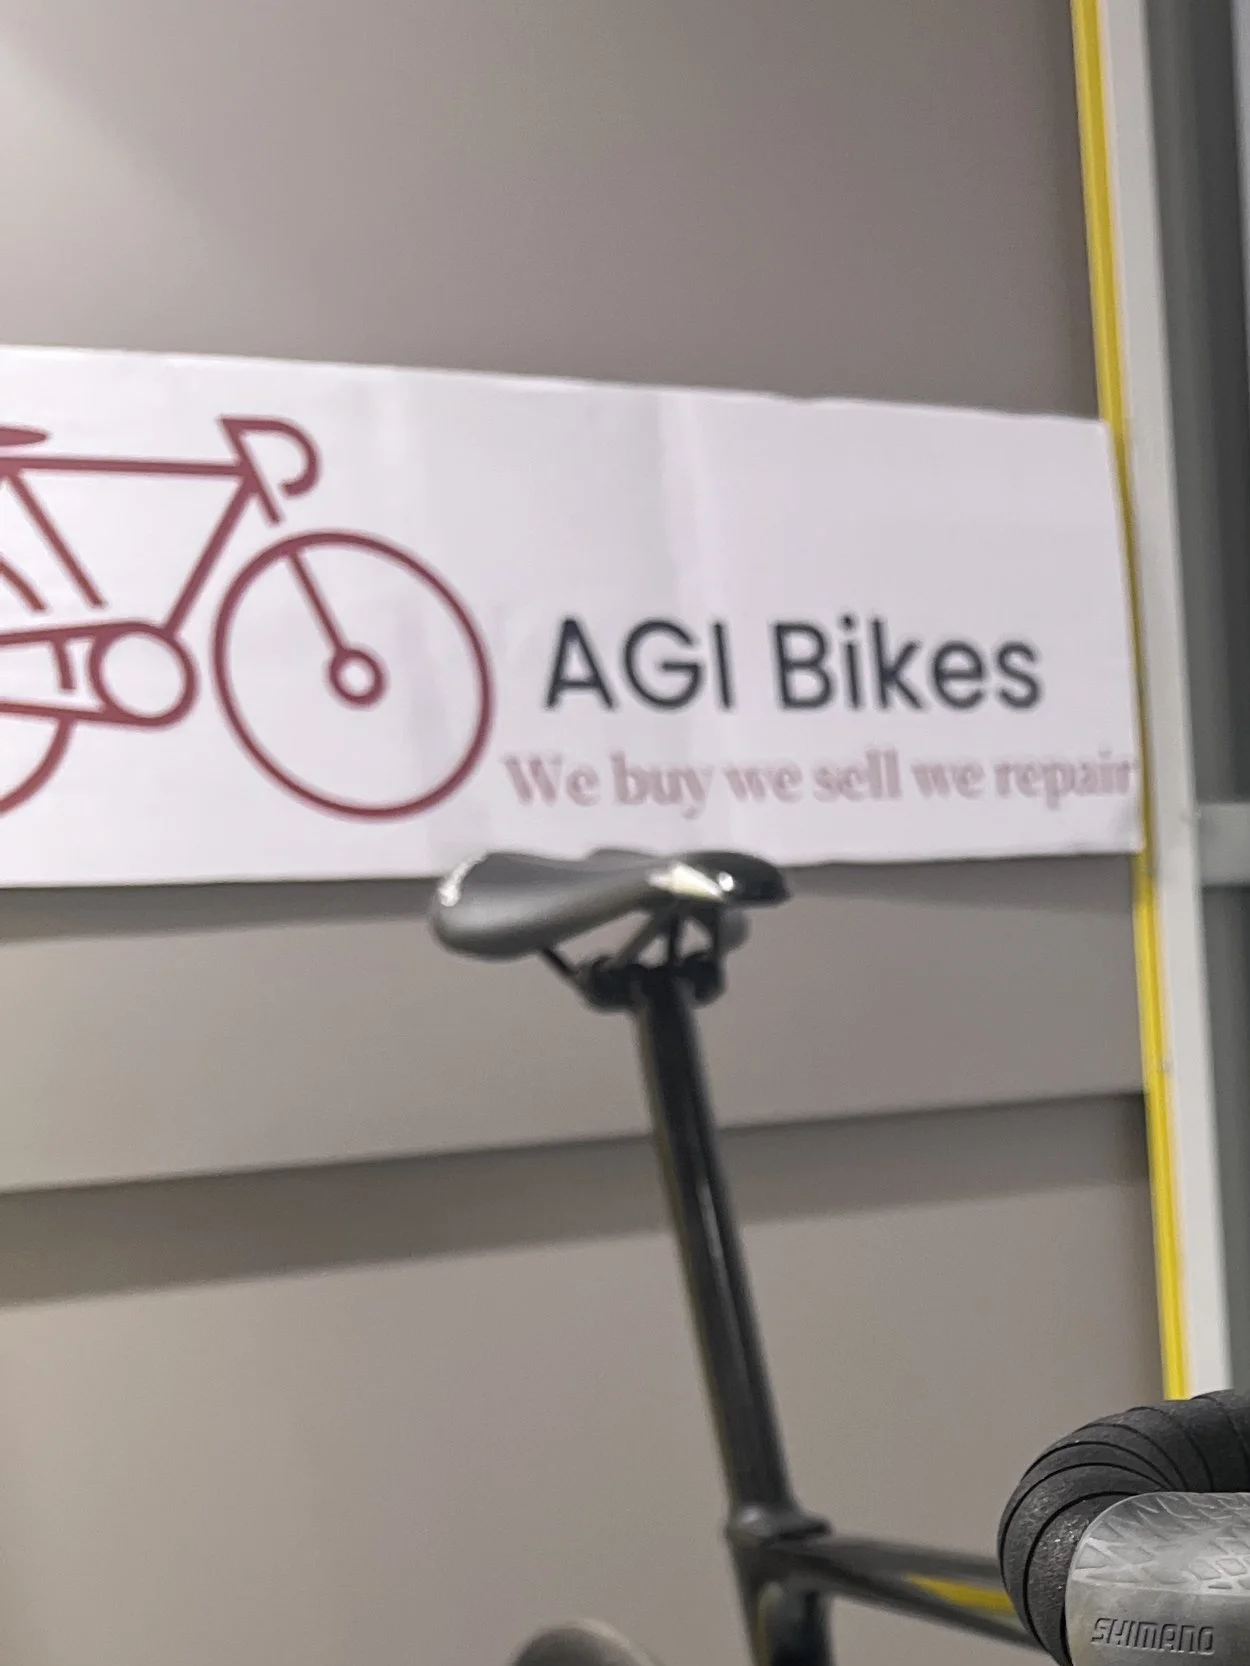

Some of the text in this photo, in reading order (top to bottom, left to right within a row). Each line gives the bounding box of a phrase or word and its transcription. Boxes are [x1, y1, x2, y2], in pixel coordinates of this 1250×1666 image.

[545, 613, 1043, 711] AGI Bikes
[501, 746, 1135, 819] We buy we sell we repair
[1091, 1616, 1216, 1655] SHIMANO
